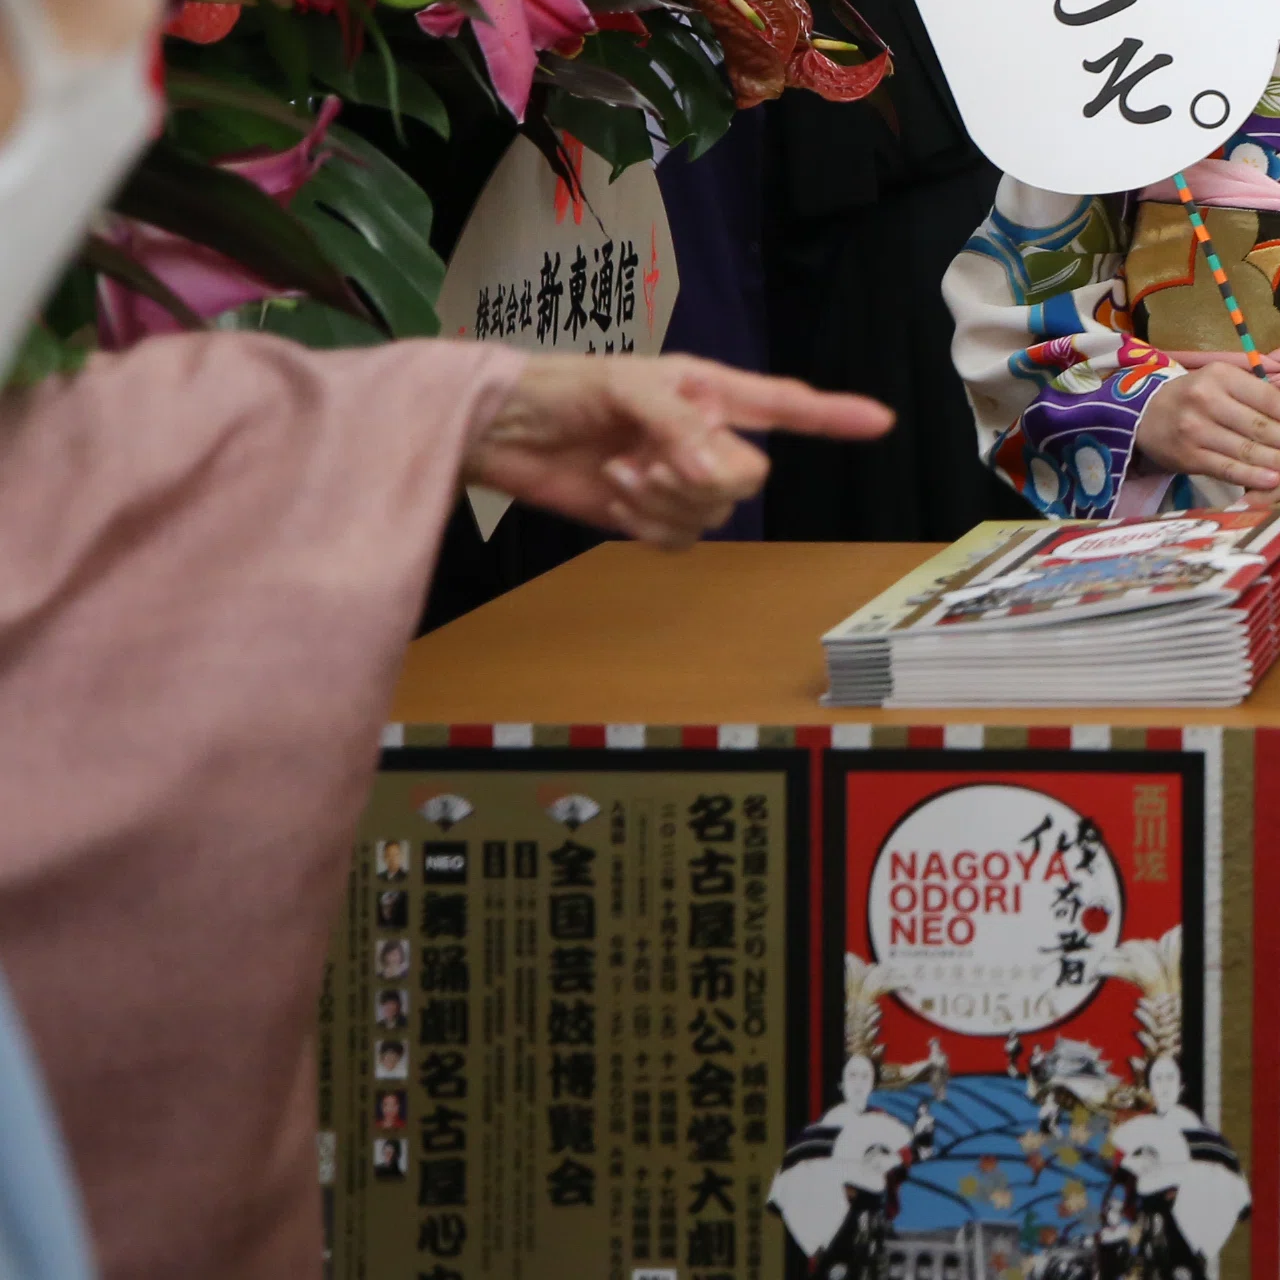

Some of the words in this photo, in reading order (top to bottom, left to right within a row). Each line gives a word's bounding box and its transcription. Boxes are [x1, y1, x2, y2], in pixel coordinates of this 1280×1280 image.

[425, 854, 465, 871] NEO
[889, 850, 1070, 882] NAGOYA
[889, 883, 1022, 914] ODORI
[889, 915, 976, 946] NEO
[548, 839, 597, 1207] 全国芸妓博覧会
[686, 793, 737, 1280] 名古屋市公会堂大劇
